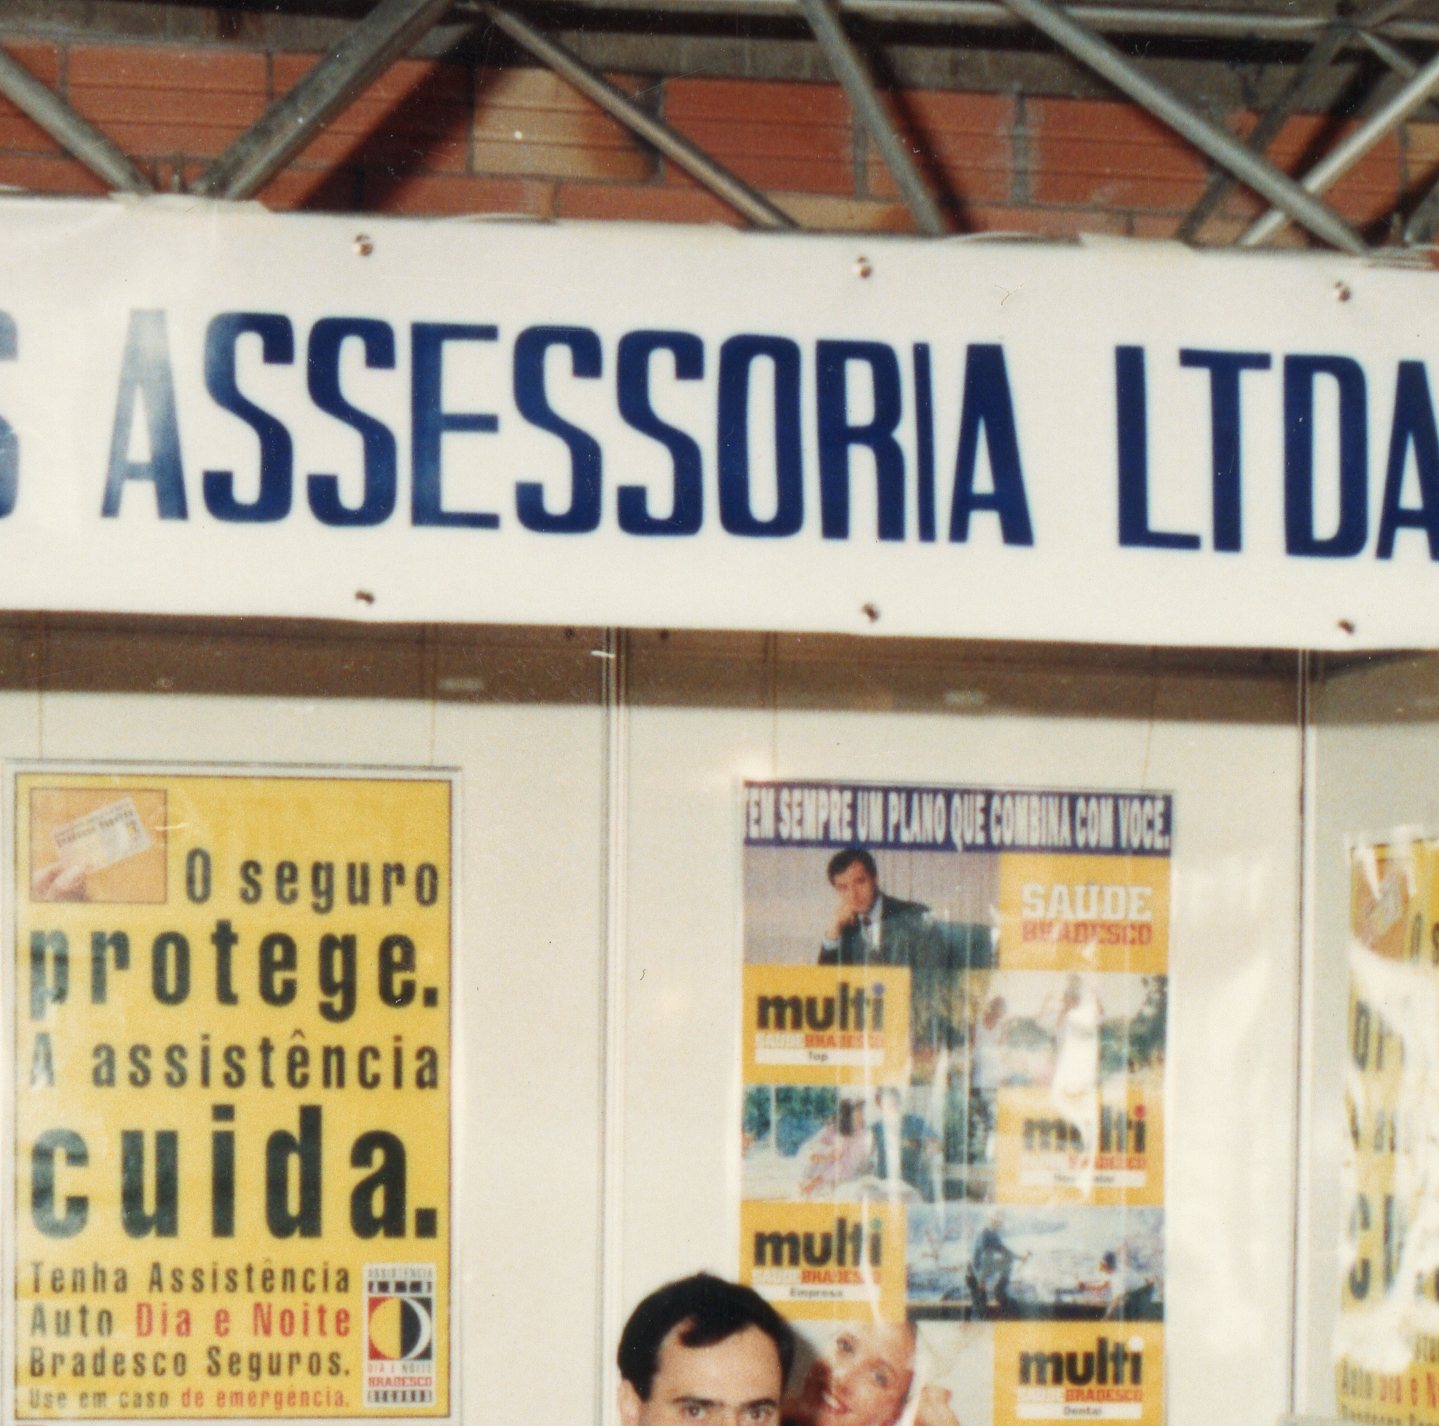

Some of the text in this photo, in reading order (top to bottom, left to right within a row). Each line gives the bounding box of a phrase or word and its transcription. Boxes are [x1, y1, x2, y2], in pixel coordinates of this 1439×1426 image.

[100, 307, 1035, 549] ASSESSORIA
[778, 787, 854, 842] SEMPRE
[887, 790, 947, 845] PLANO
[950, 793, 987, 853] QUE
[989, 794, 1072, 848] COMBINA
[1074, 796, 1115, 849] COM
[185, 847, 440, 915] O seguro
[29, 918, 440, 1024] protege.
[756, 981, 886, 1032] multi
[30, 1028, 440, 1091] A assistência
[809, 1051, 829, 1062] Top
[30, 1103, 439, 1240] cuida.
[754, 1216, 882, 1268] multi
[30, 1258, 351, 1296] Tenha Assistência
[30, 1301, 352, 1339] Auto Dia e Noite
[30, 1345, 351, 1383] Bradesco Seguros.
[1019, 1335, 1143, 1386] multi
[30, 1387, 68, 1410] Use
[79, 1389, 108, 1410] em
[119, 1389, 170, 1410] caso
[181, 1386, 205, 1409] de
